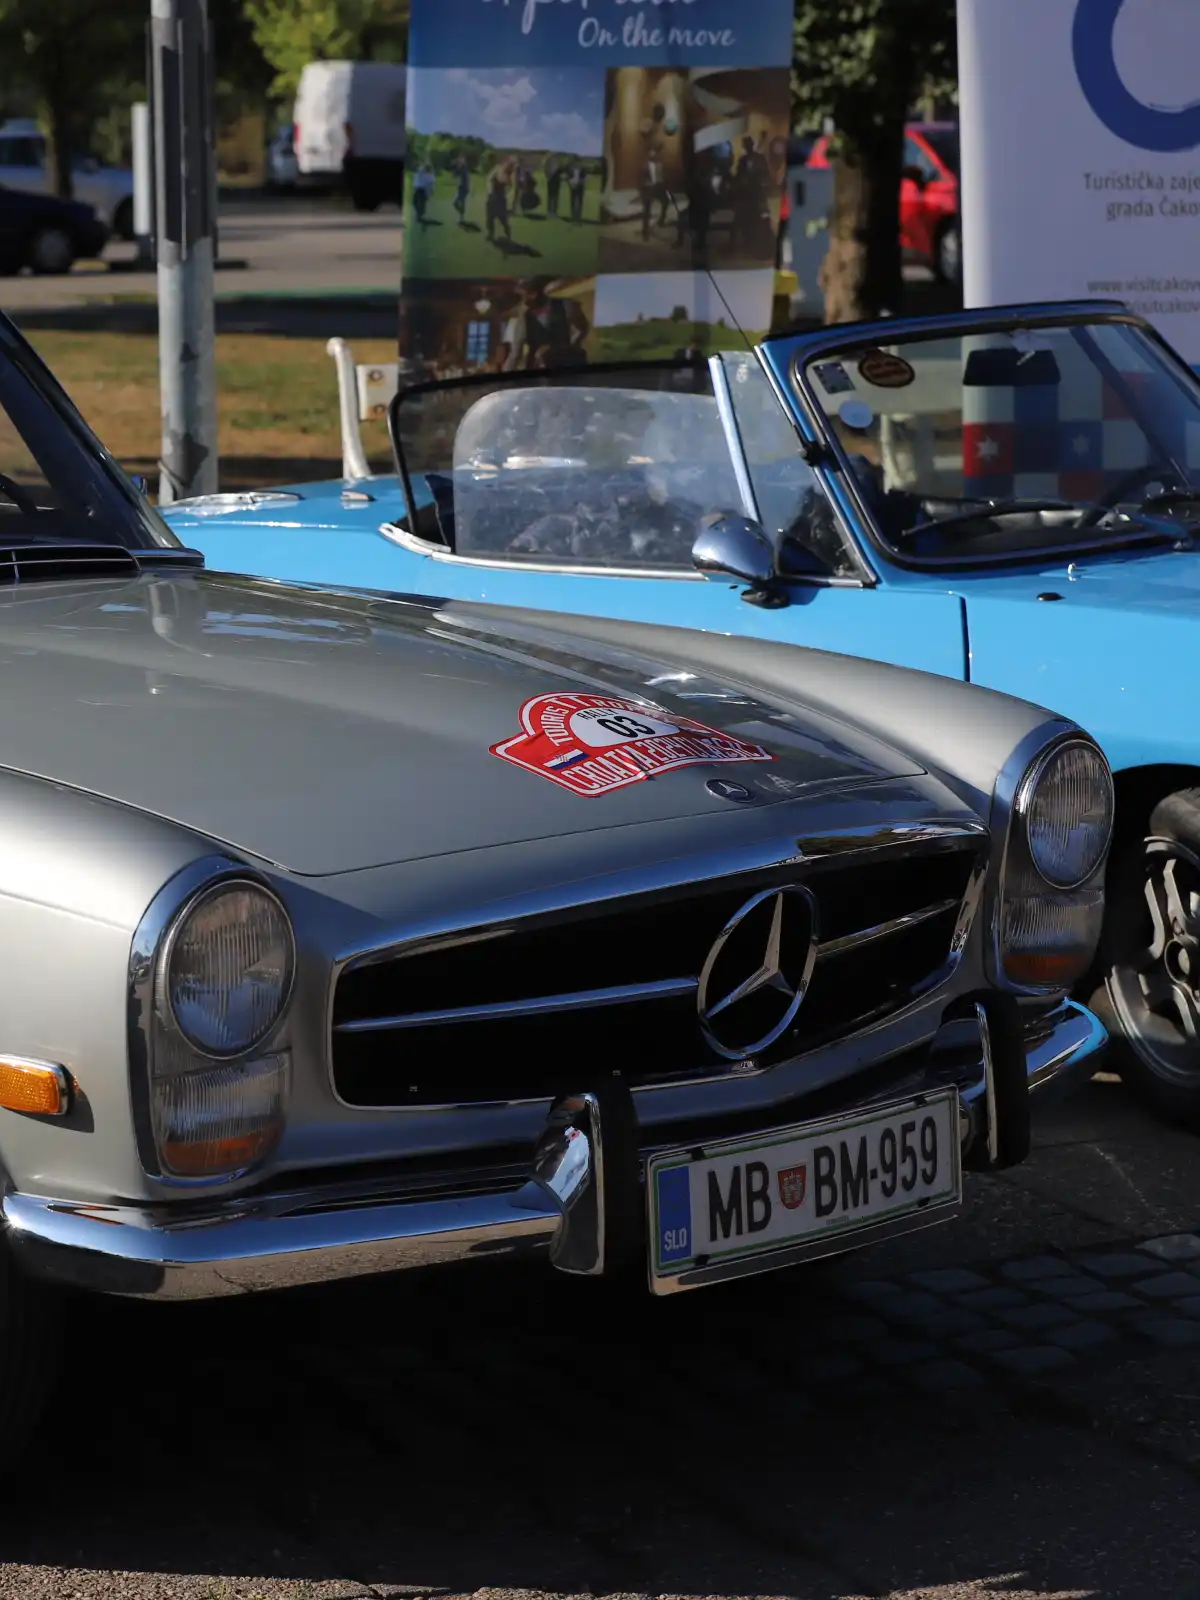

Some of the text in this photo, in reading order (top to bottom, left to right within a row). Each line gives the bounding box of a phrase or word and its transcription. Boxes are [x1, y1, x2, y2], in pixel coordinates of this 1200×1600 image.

[578, 17, 618, 48] On
[622, 13, 664, 47] the
[668, 28, 735, 47] move
[1083, 170, 1164, 190] Turistička
[1106, 196, 1200, 221] grada Čako
[576, 708, 618, 721] RALLY
[597, 716, 655, 738] 03
[561, 745, 659, 789] CROATIA
[708, 1116, 938, 1242] MB BM-959
[664, 1227, 687, 1250] SLO
